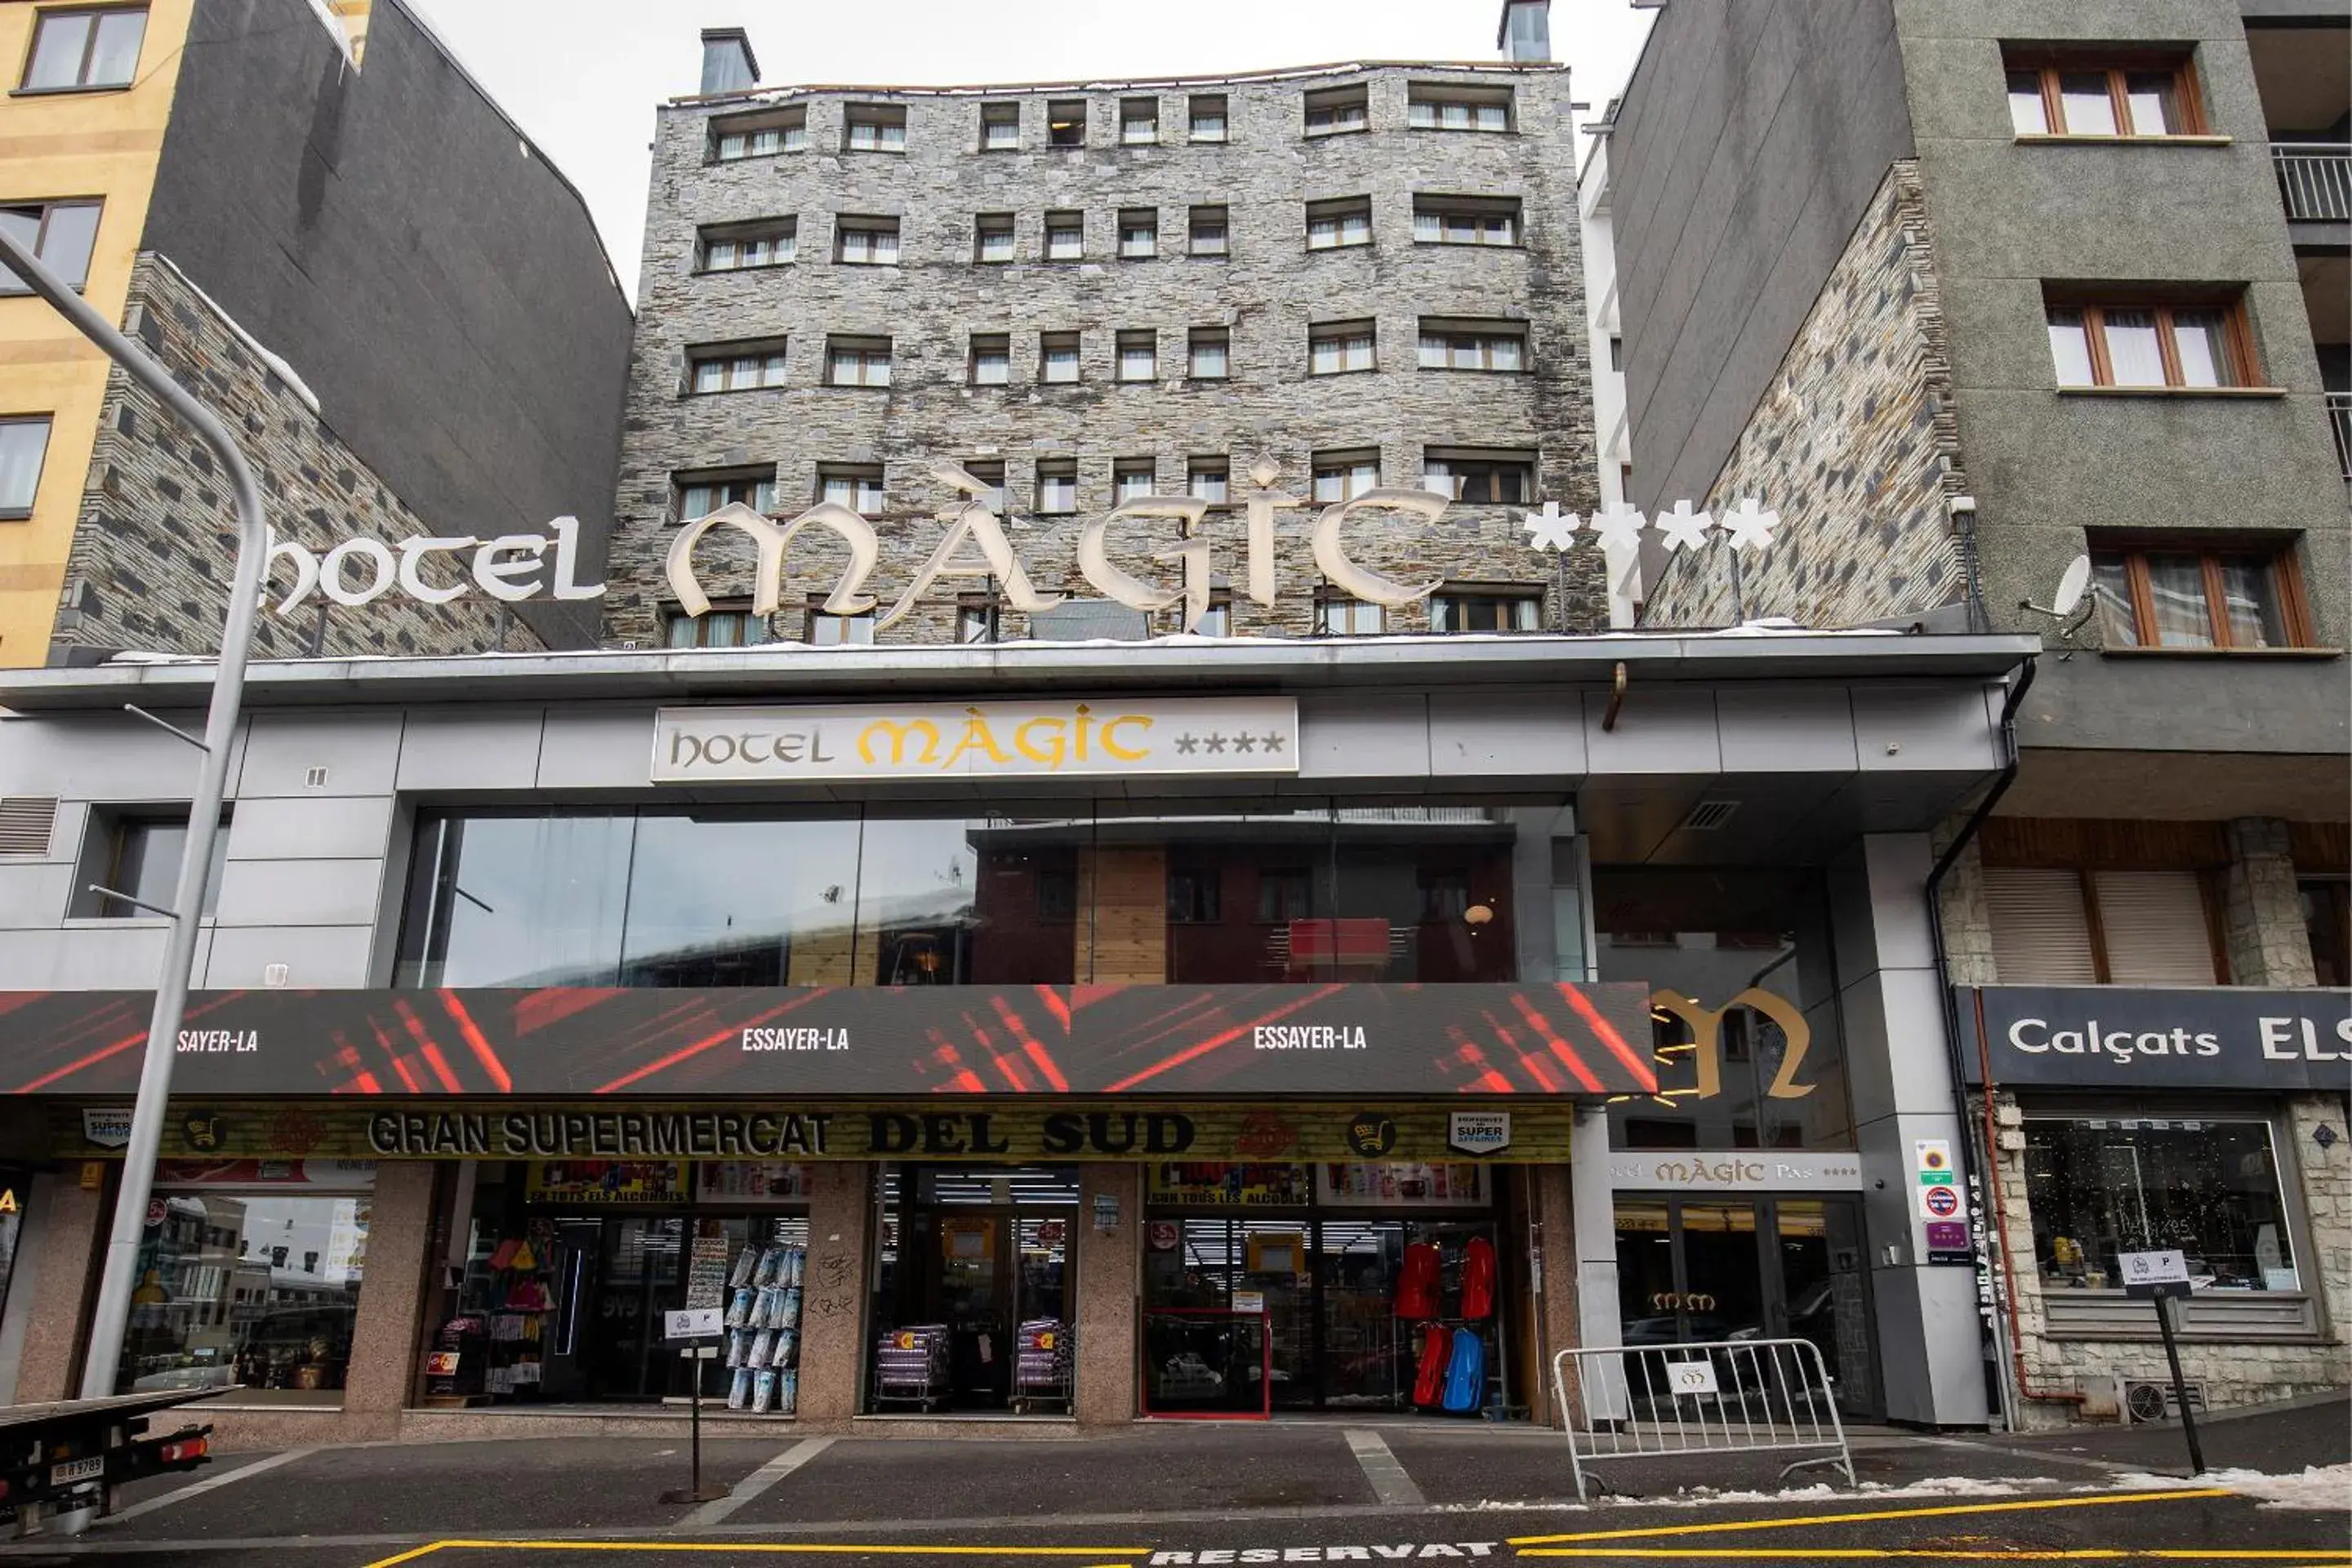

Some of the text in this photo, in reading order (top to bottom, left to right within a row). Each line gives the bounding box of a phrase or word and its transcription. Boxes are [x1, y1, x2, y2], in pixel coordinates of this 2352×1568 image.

[176, 1030, 258, 1052] SAYER-LA
[742, 1027, 849, 1051] ESSAYER-LA
[1254, 1026, 1367, 1049] ESSAYER-LA
[2008, 1018, 2221, 1064] Calçats
[368, 1111, 1195, 1155] GRAN SUPERMERCAT DEL SUD
[1458, 1127, 1503, 1136] SUPER
[1775, 1164, 1813, 1179] Pas
[614, 1190, 684, 1202] ALCOHOLS
[1182, 1192, 1216, 1203] TOUS
[1219, 1192, 1241, 1204] LES
[1246, 1192, 1305, 1204] ALCOOLS
[1149, 1542, 1499, 1566] RESERVAT
